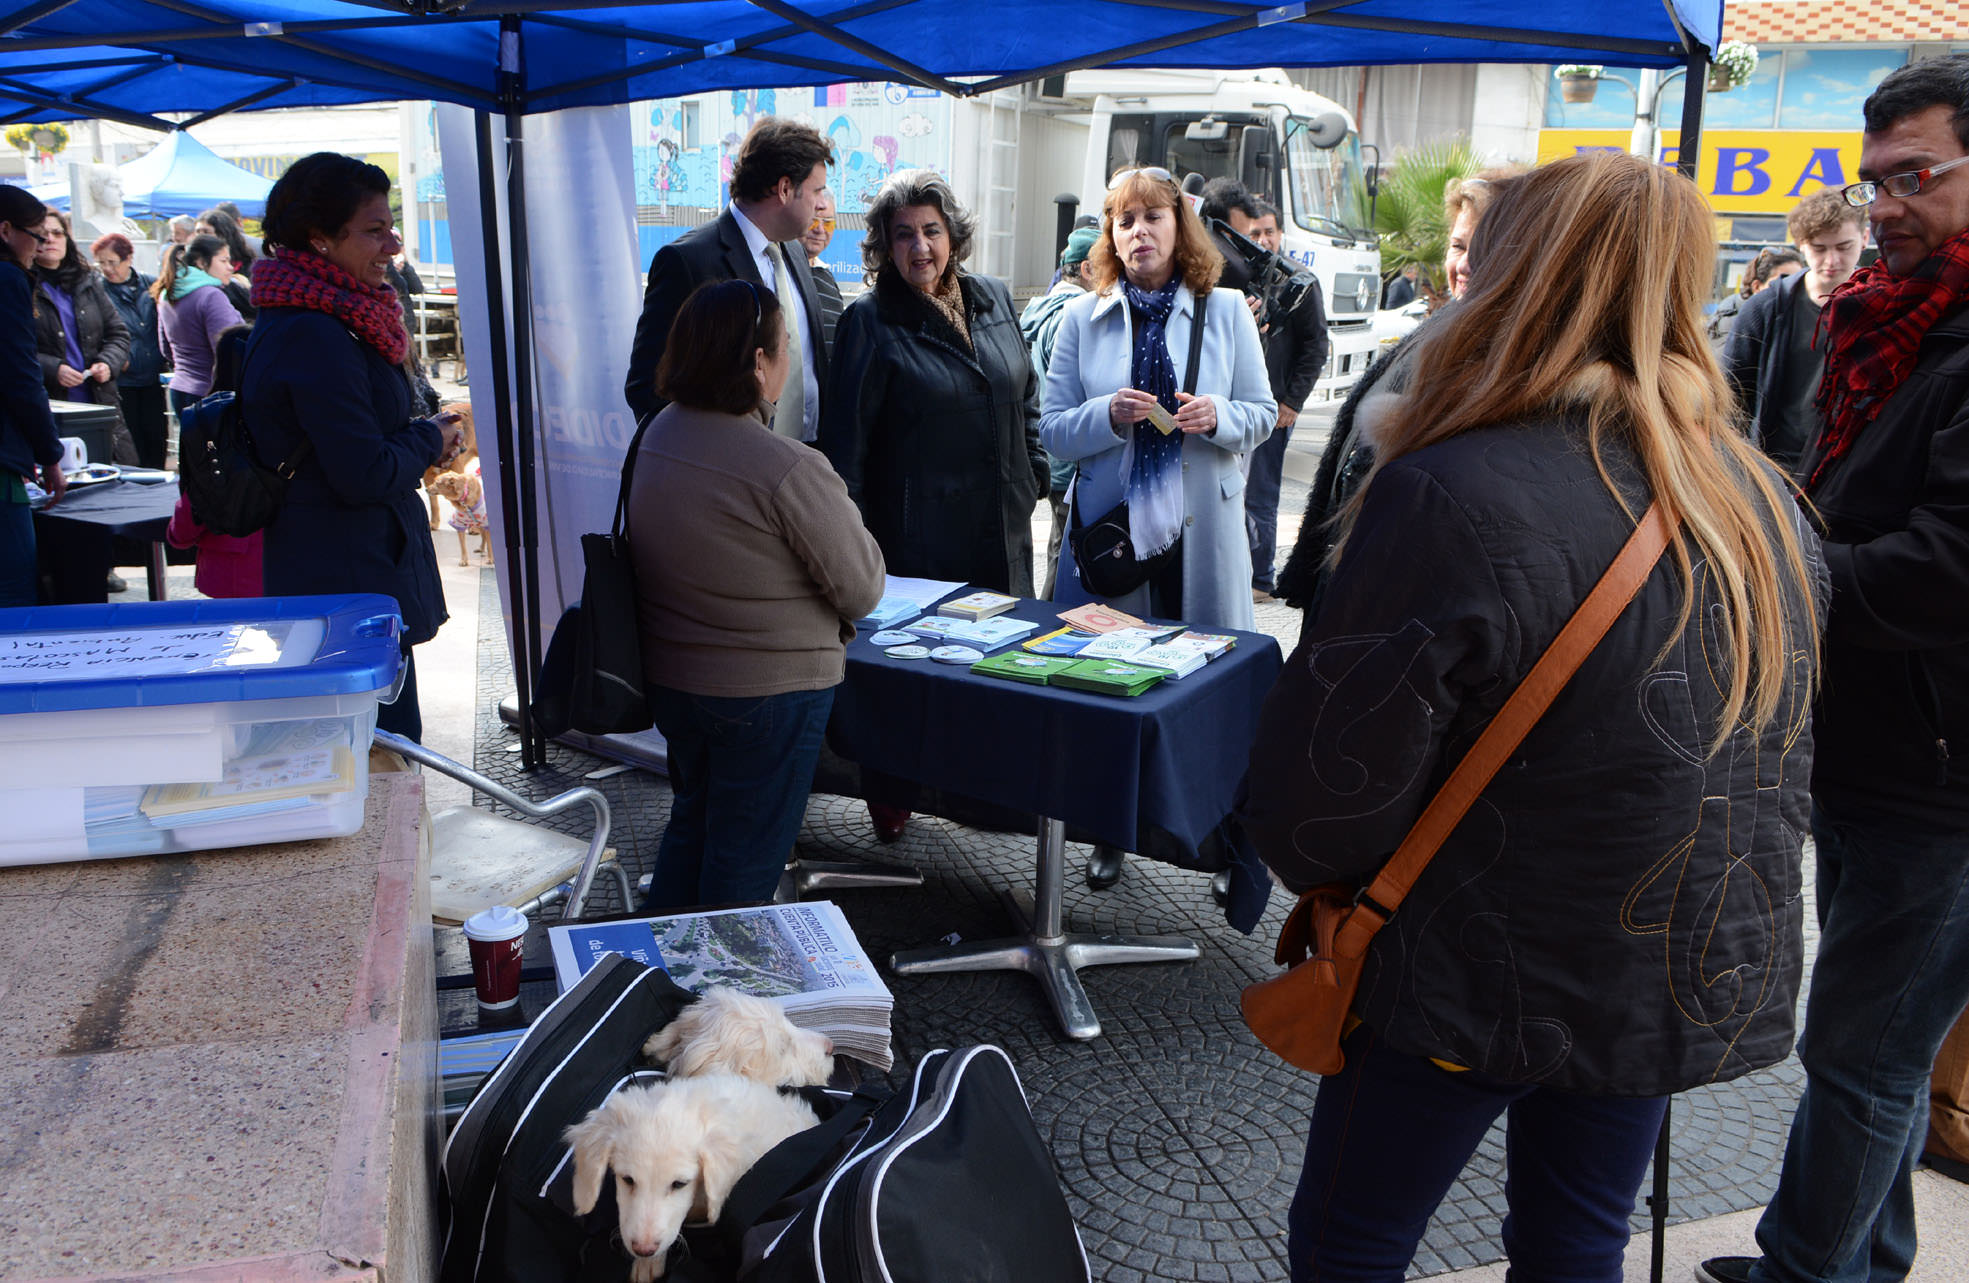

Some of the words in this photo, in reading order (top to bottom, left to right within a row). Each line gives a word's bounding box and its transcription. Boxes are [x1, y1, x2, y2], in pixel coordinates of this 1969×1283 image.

[780, 907, 802, 931] CUENTA
[797, 906, 838, 953] INFORMATIVO
[631, 949, 649, 965] Viñ
